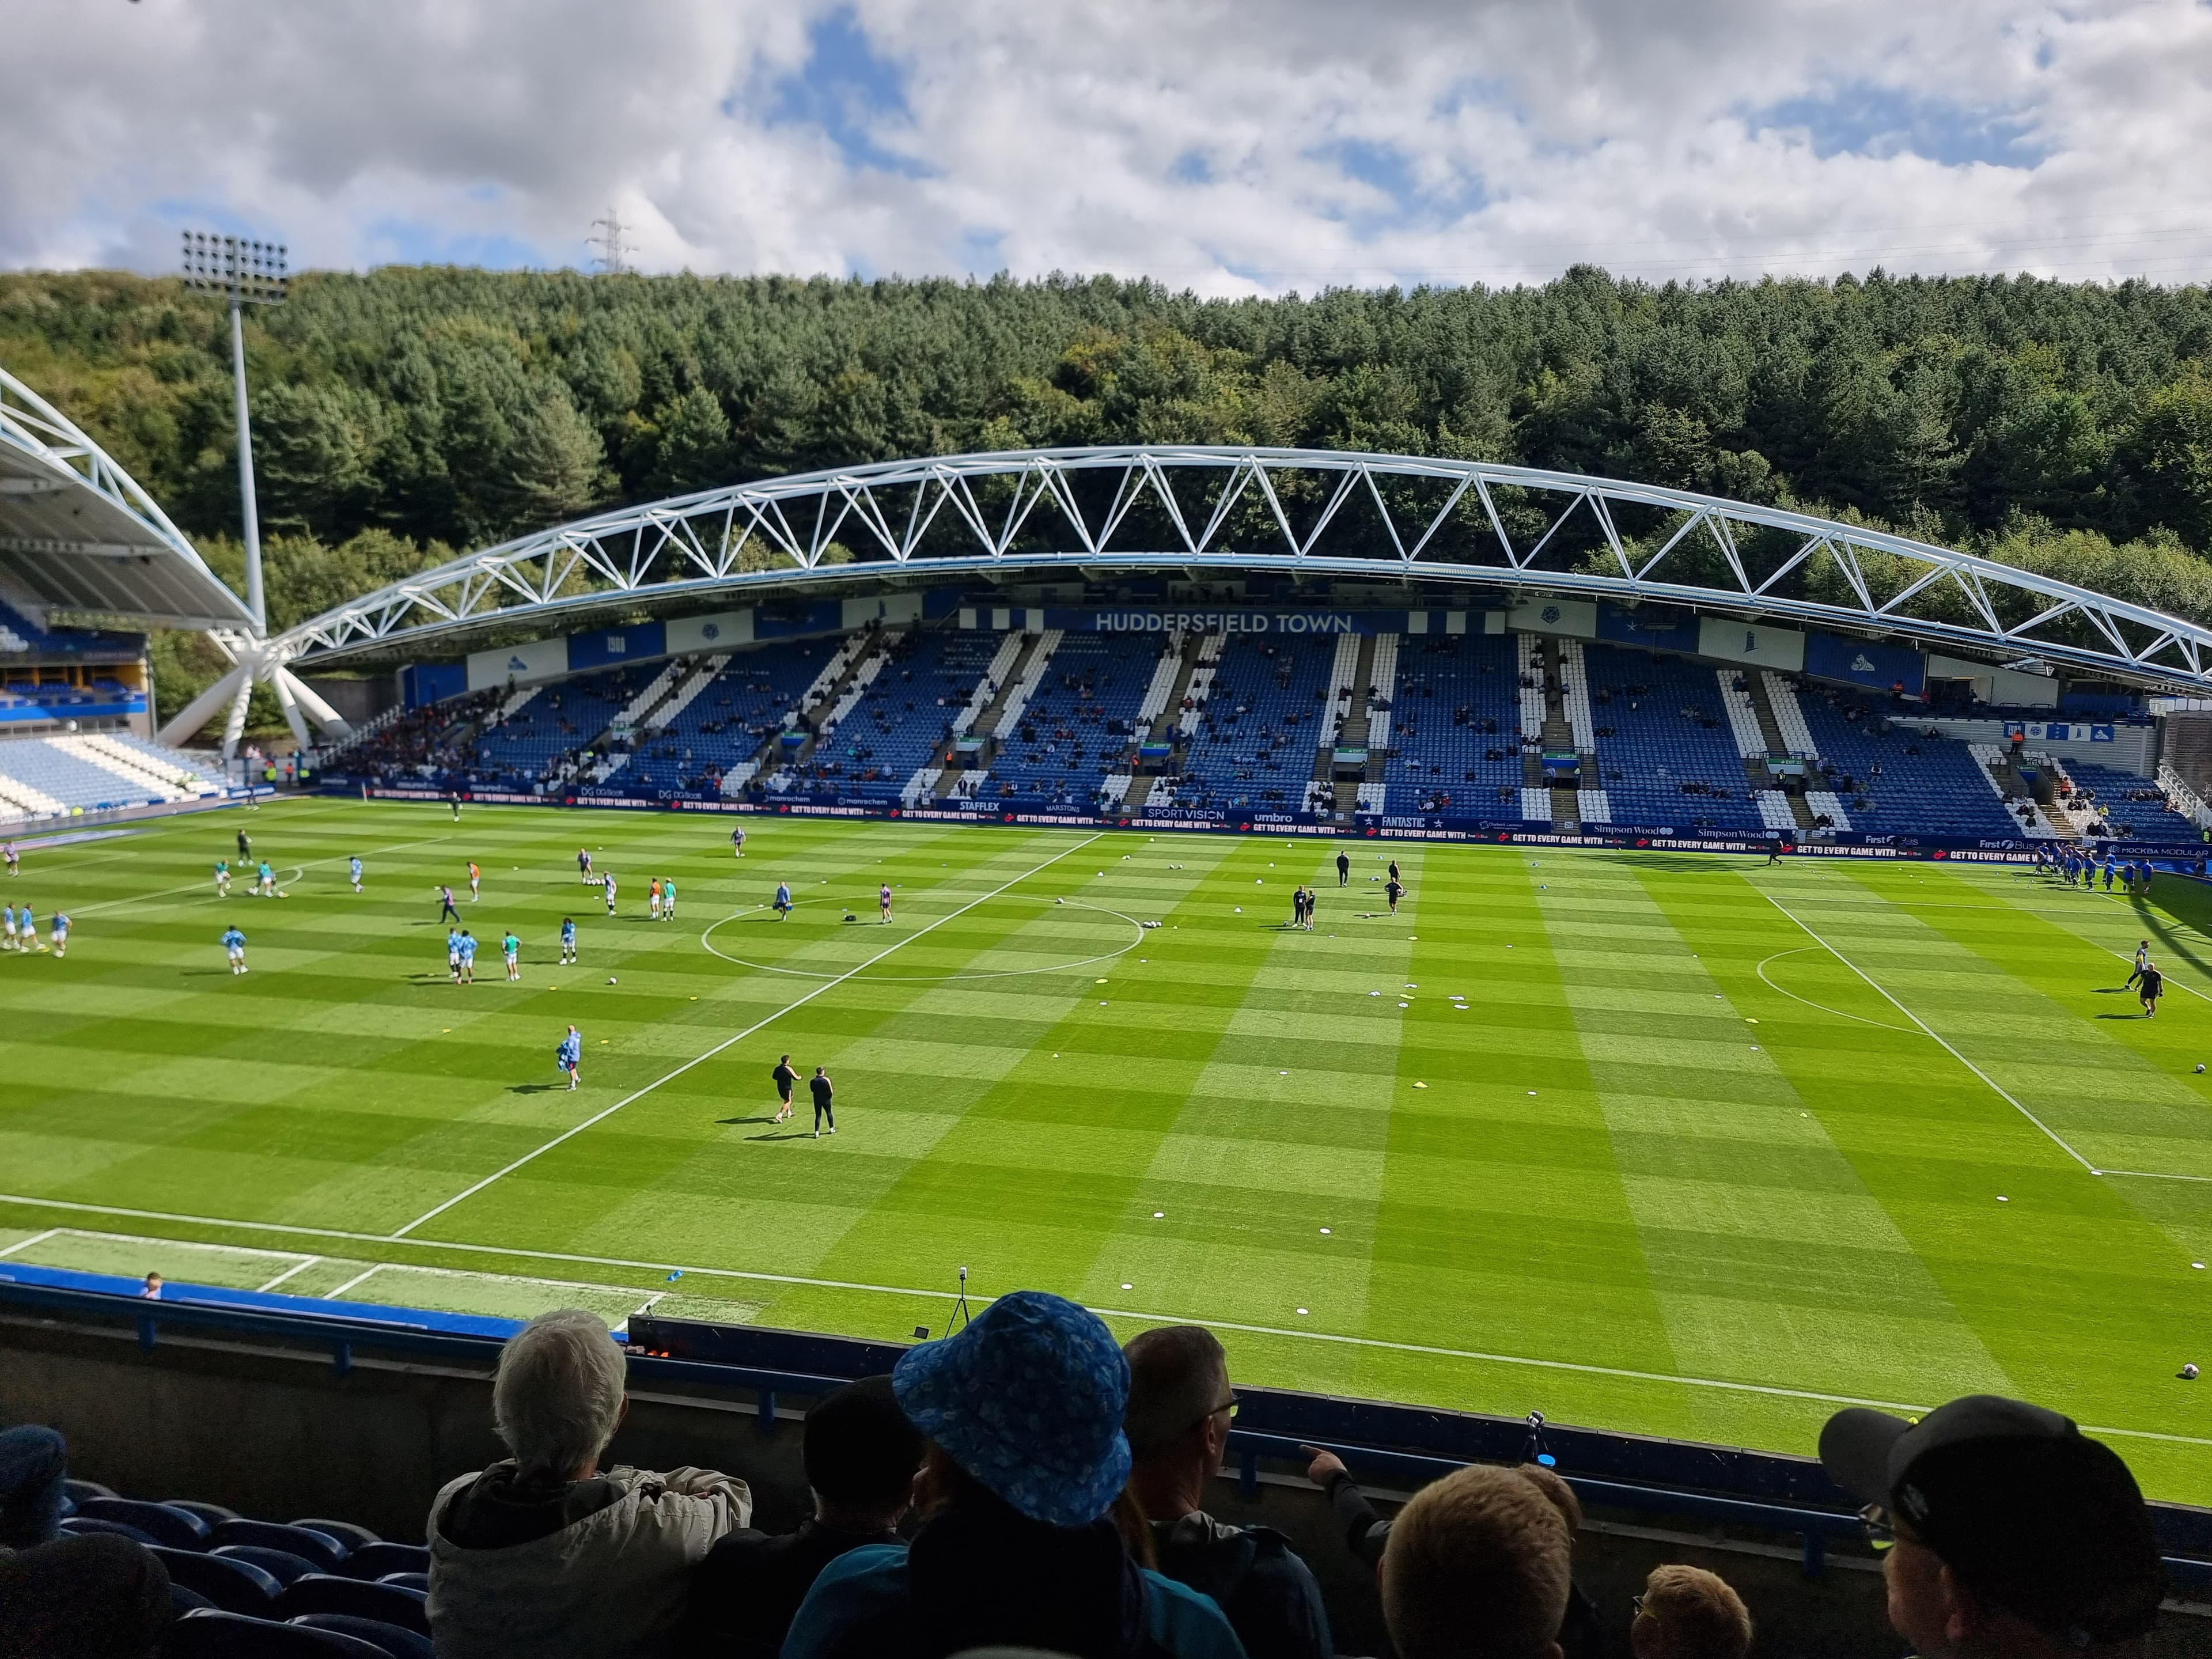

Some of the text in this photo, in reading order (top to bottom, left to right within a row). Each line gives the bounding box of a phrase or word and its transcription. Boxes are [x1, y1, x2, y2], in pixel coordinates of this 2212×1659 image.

[1096, 613, 1352, 633] HUDDERSFIELD TOWN
[683, 801, 694, 809] GET
[695, 801, 702, 809] TO
[703, 802, 721, 810] EVERY
[738, 803, 754, 811] WITH
[791, 805, 802, 813] GET
[804, 806, 810, 814] TO
[811, 806, 830, 815] EVERY
[848, 808, 864, 816] WITH
[959, 801, 999, 812] STAFFLEX
[1046, 805, 1081, 813] MARSTONS
[902, 810, 914, 818] GET
[915, 810, 922, 819] TO
[923, 811, 942, 819] EVERY
[961, 812, 977, 820] WITH
[1038, 815, 1058, 823] EVERY
[1148, 808, 1225, 820] SPORT VISION
[1255, 813, 1293, 823] umbro
[1144, 819, 1153, 827] TO
[1153, 820, 1173, 828] EVERY
[1382, 816, 1425, 828] FANTASTIC
[1267, 824, 1275, 832] TO
[1276, 824, 1297, 833] EVERY
[1297, 825, 1317, 834] GAME
[1317, 826, 1336, 835] WITH
[1380, 828, 1466, 839] GET TO EVERY GAME WITH
[1594, 825, 1659, 835] Simpson Wood
[1698, 829, 1764, 839] Simpson Wood
[1513, 834, 1603, 844] GET TO EVERY GAME WITH
[1865, 835, 1885, 844] First
[1979, 839, 2035, 850] First Bus
[1652, 839, 1746, 851] GET TO EVERY GAME WITH
[1797, 845, 1896, 857] GET TO EVERY GAME WITH
[1950, 851, 2054, 863] GET TO EVERY GAME WH
